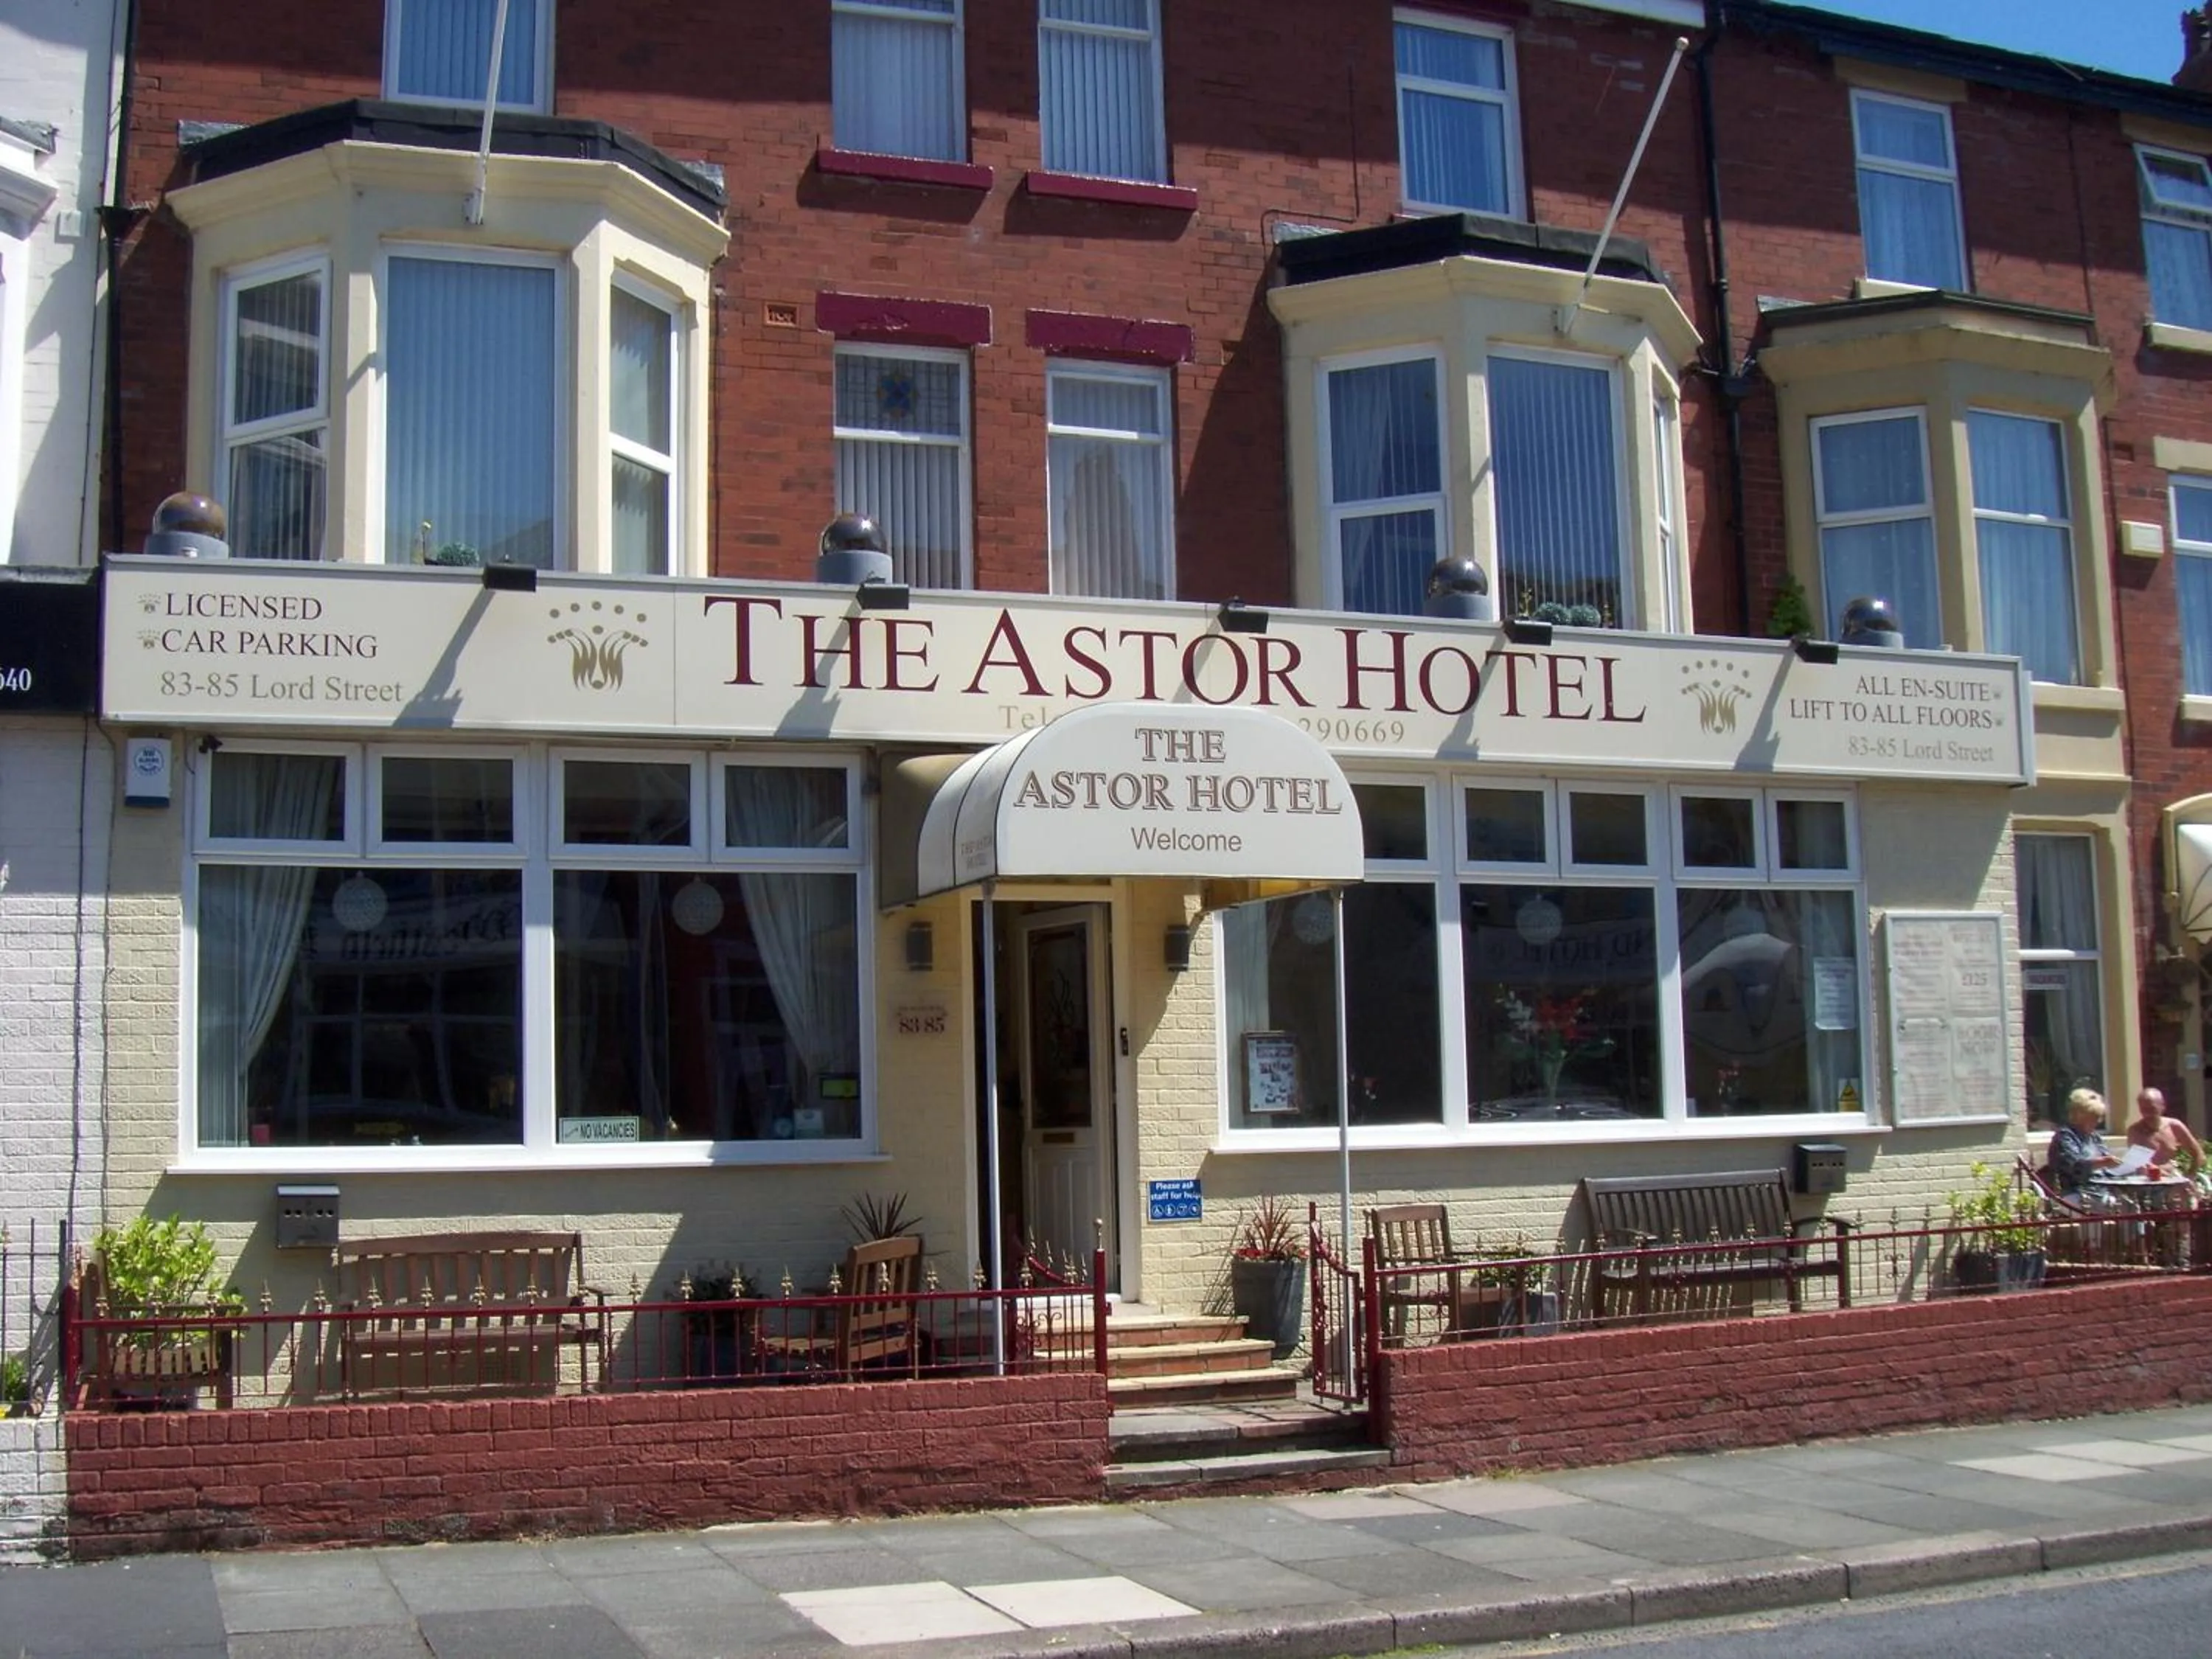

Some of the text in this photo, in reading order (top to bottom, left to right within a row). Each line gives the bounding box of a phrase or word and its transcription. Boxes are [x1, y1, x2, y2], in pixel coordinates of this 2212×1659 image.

[166, 592, 322, 621] LICENSED
[161, 629, 378, 658] CAR PARKING
[704, 595, 1647, 723] THE ASTOR HOTEL
[161, 670, 403, 703] 83-85 Lord Street
[1856, 675, 1990, 702] ALL EN-SUITE
[1790, 699, 1992, 729] LIFT TO ALL FLOORS
[1135, 728, 1226, 762] THE
[1848, 736, 1994, 762] 83-85 Lord Street
[1014, 771, 1343, 814] ASTOR HOTEL
[1131, 827, 1242, 853] Welcome
[580, 1122, 592, 1139] NO
[593, 1121, 635, 1139] VACANCIES
[1151, 1191, 1169, 1200] staff
[1170, 1191, 1181, 1200] for
[1155, 1180, 1194, 1190] Please ask
